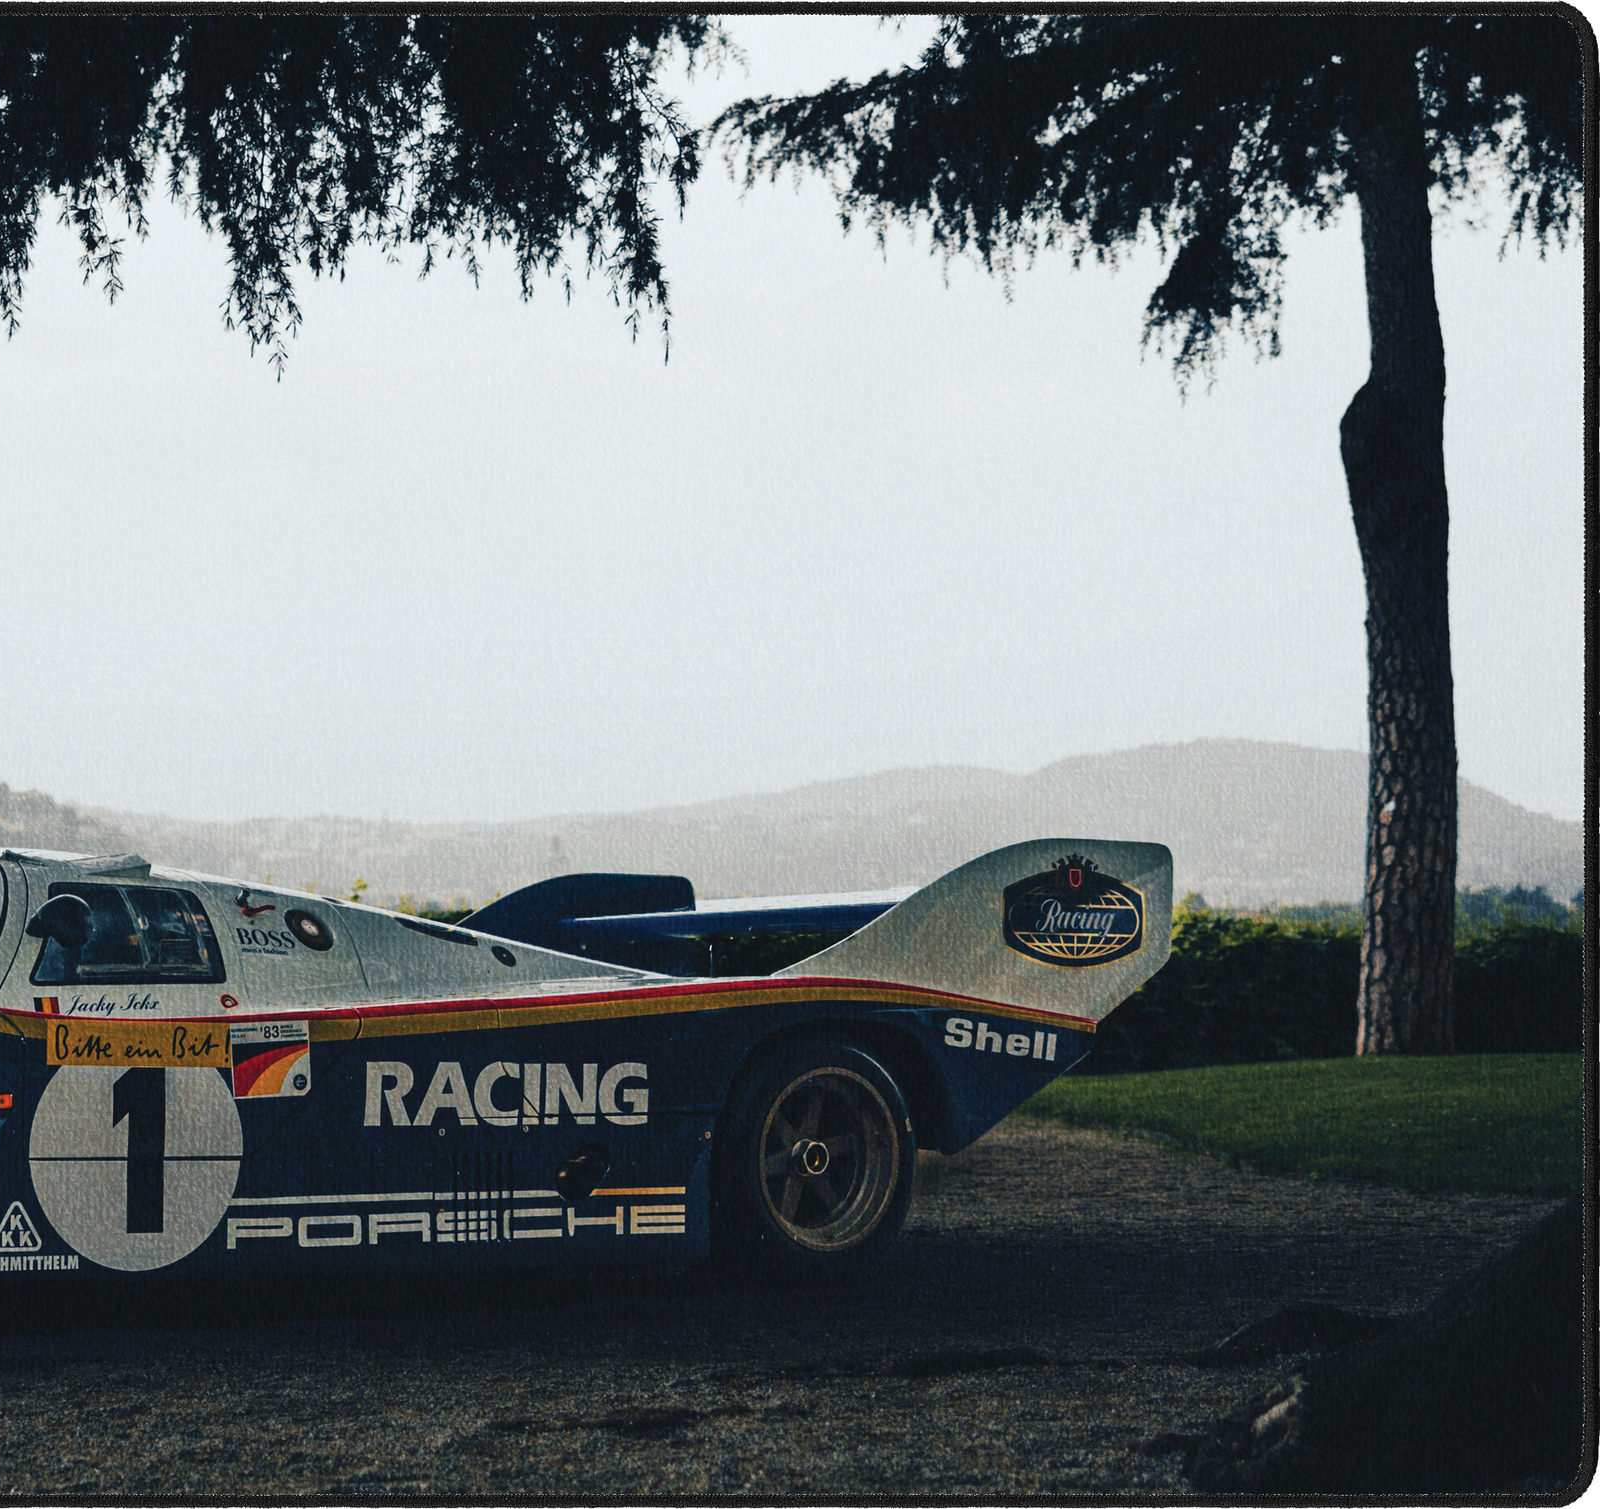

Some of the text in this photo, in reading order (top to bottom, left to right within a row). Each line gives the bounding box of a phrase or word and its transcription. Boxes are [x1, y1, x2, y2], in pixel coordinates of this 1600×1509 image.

[236, 928, 295, 949] BOSS
[1035, 899, 1115, 937] Racing
[66, 993, 161, 1016] Jacky Ickx
[54, 1023, 114, 1062] Bitte
[124, 1040, 162, 1059] ein
[944, 1018, 1057, 1061] Shell
[364, 1061, 649, 1126] RACING
[111, 1067, 165, 1234] 1
[227, 1205, 686, 1250] PORSCHE
